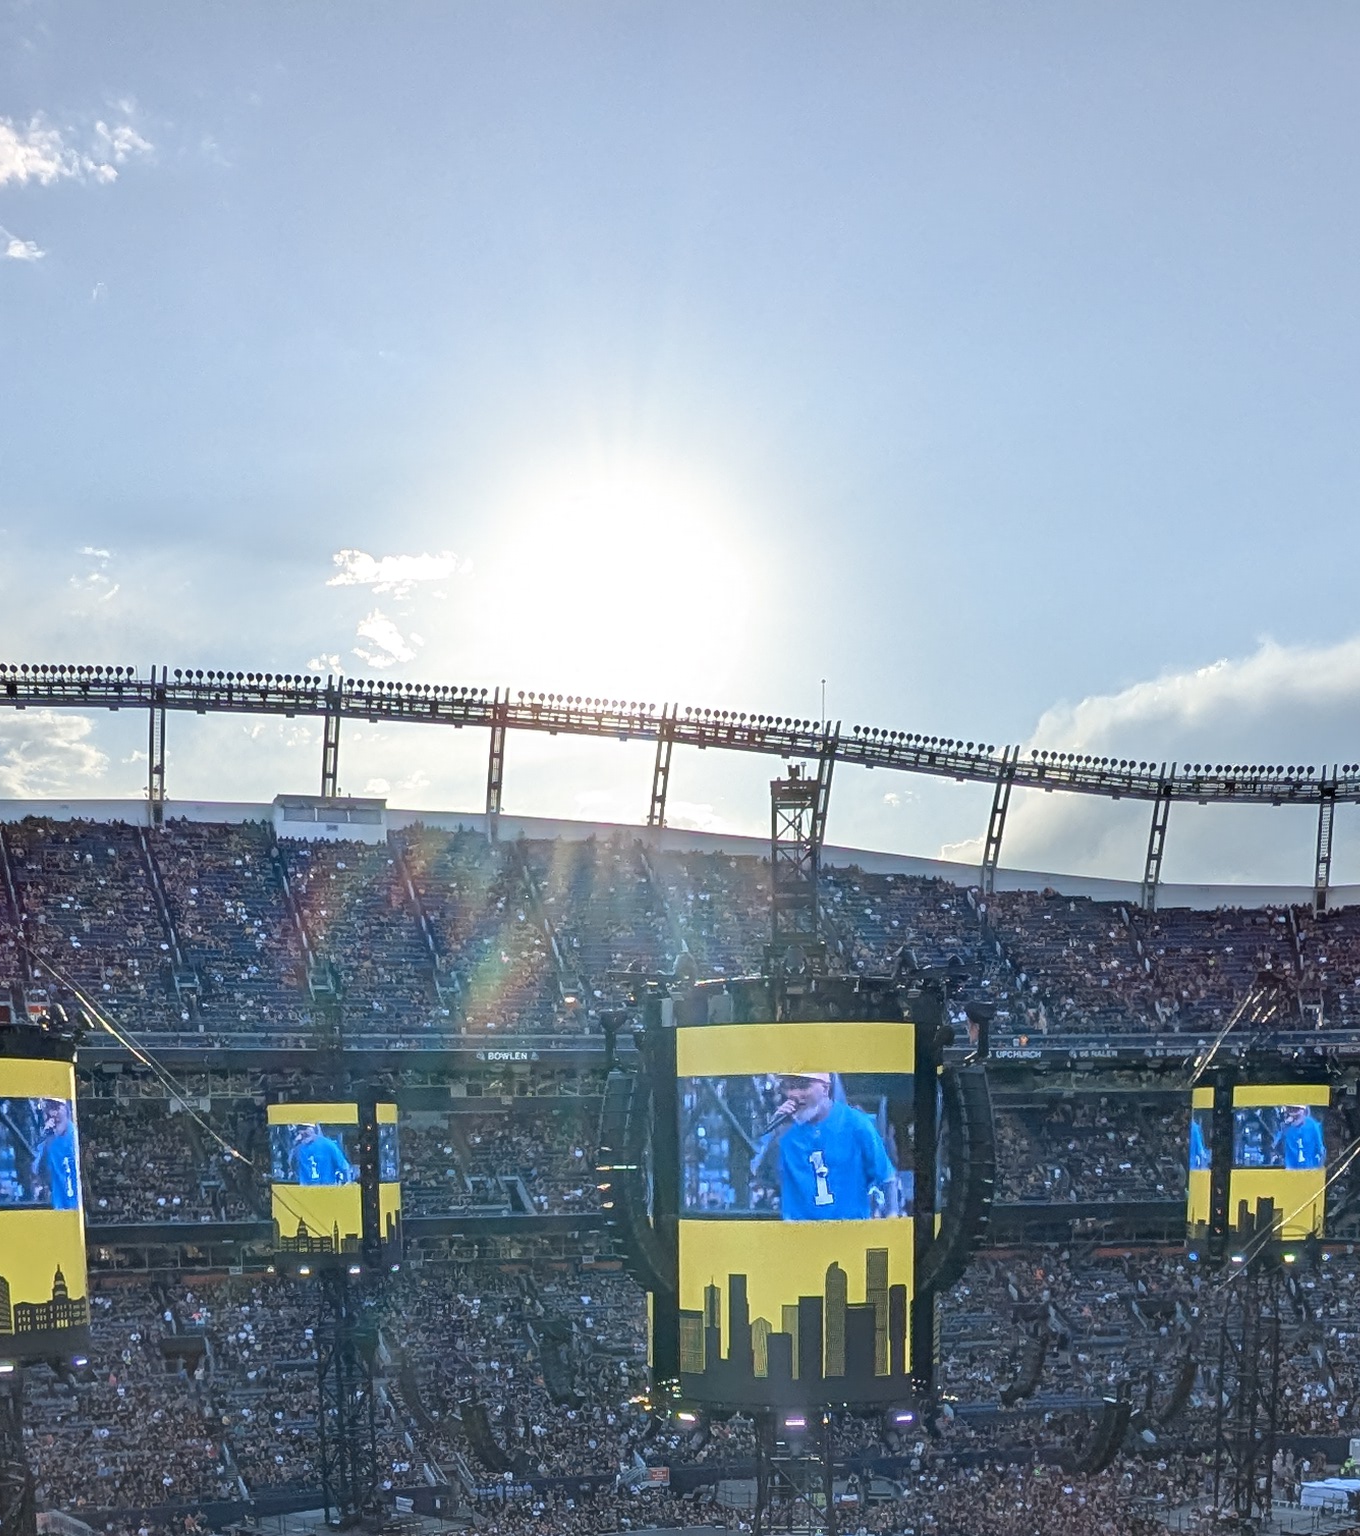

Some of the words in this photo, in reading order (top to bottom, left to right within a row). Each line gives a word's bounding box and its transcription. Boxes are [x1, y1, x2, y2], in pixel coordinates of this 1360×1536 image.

[487, 1051, 528, 1061] BOWLEN
[995, 1050, 1042, 1059] UPCHURCH
[808, 1150, 835, 1206] 1
